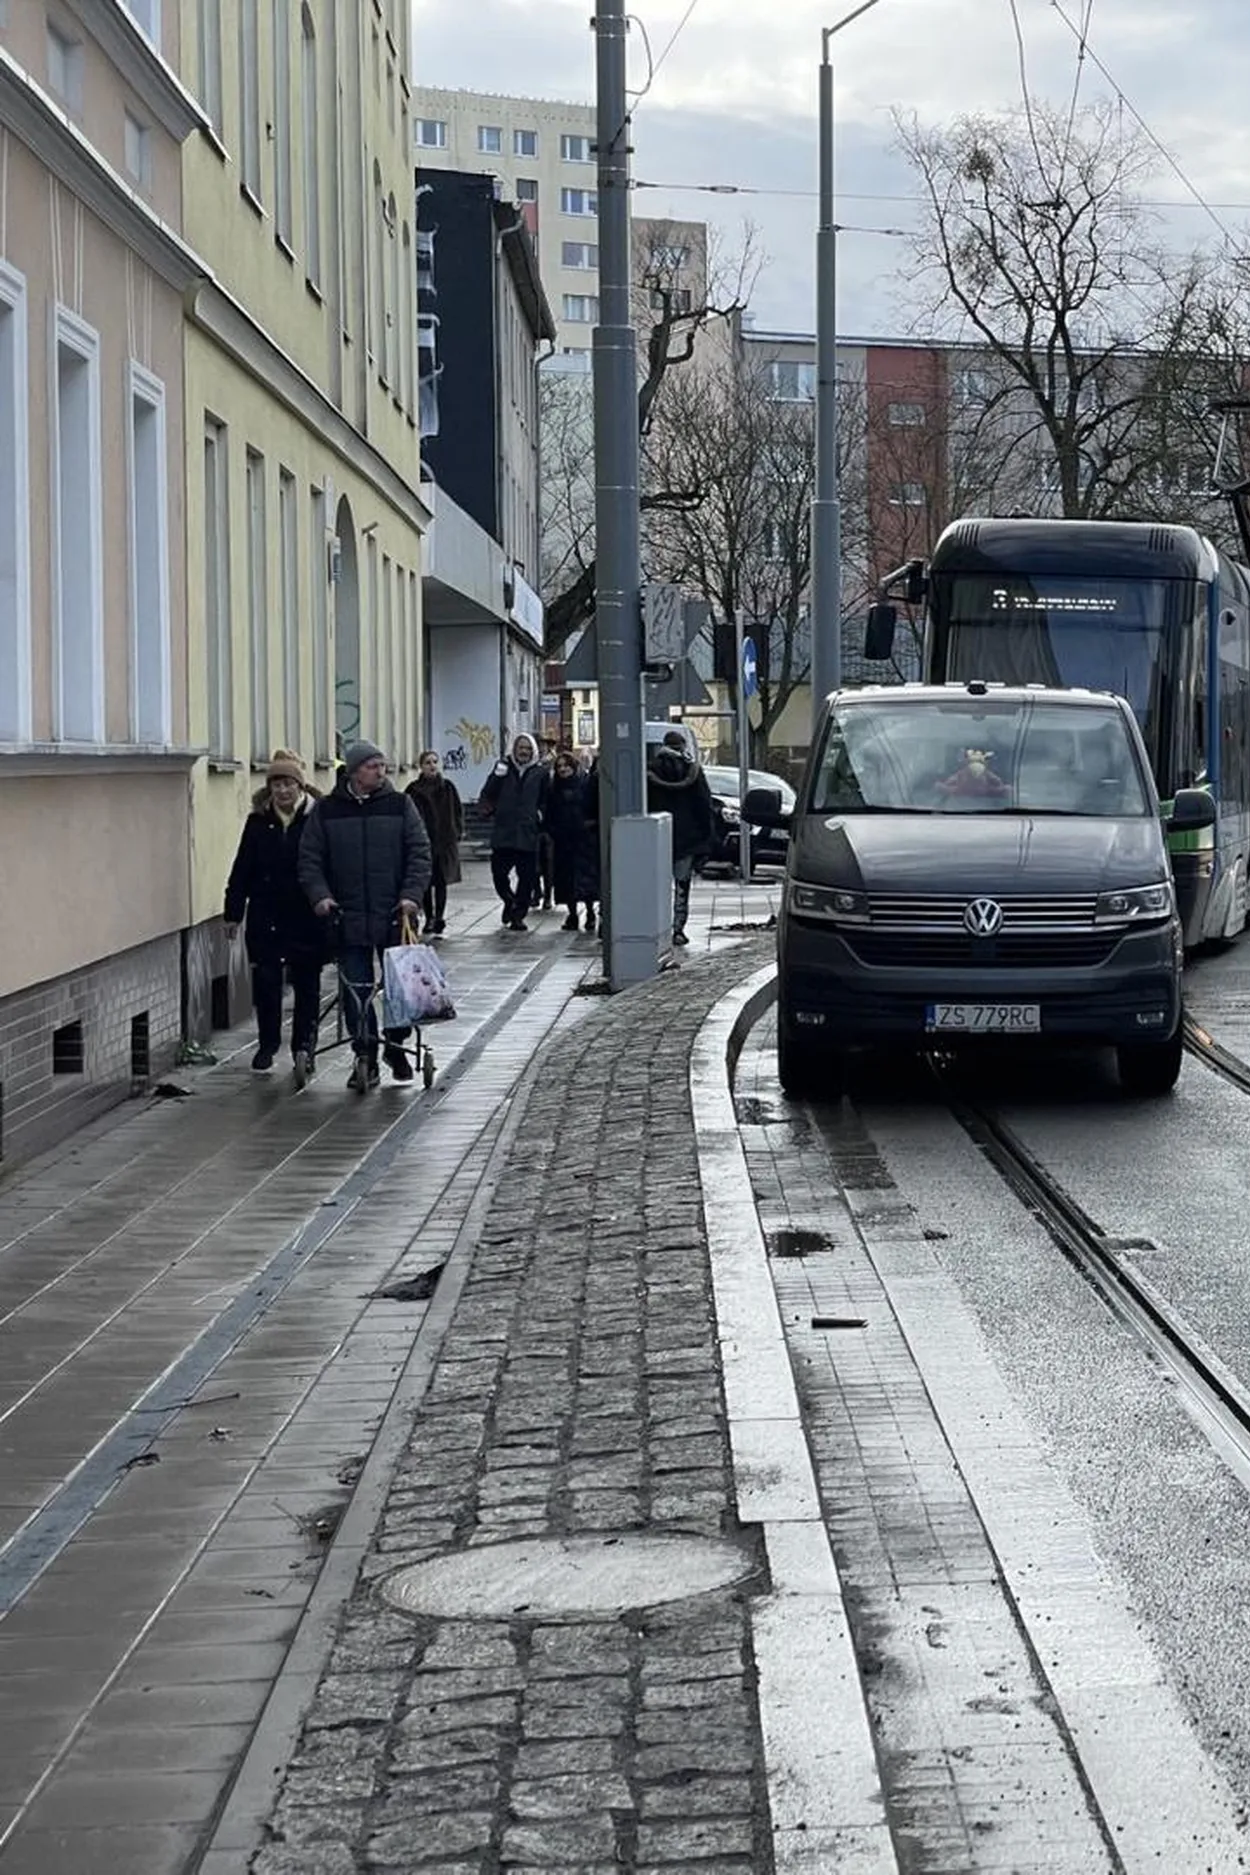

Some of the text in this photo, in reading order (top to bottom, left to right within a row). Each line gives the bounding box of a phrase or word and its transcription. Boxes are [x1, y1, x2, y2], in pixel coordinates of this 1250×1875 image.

[966, 900, 1001, 934] VW
[940, 1006, 1035, 1026] ZS 779RC
